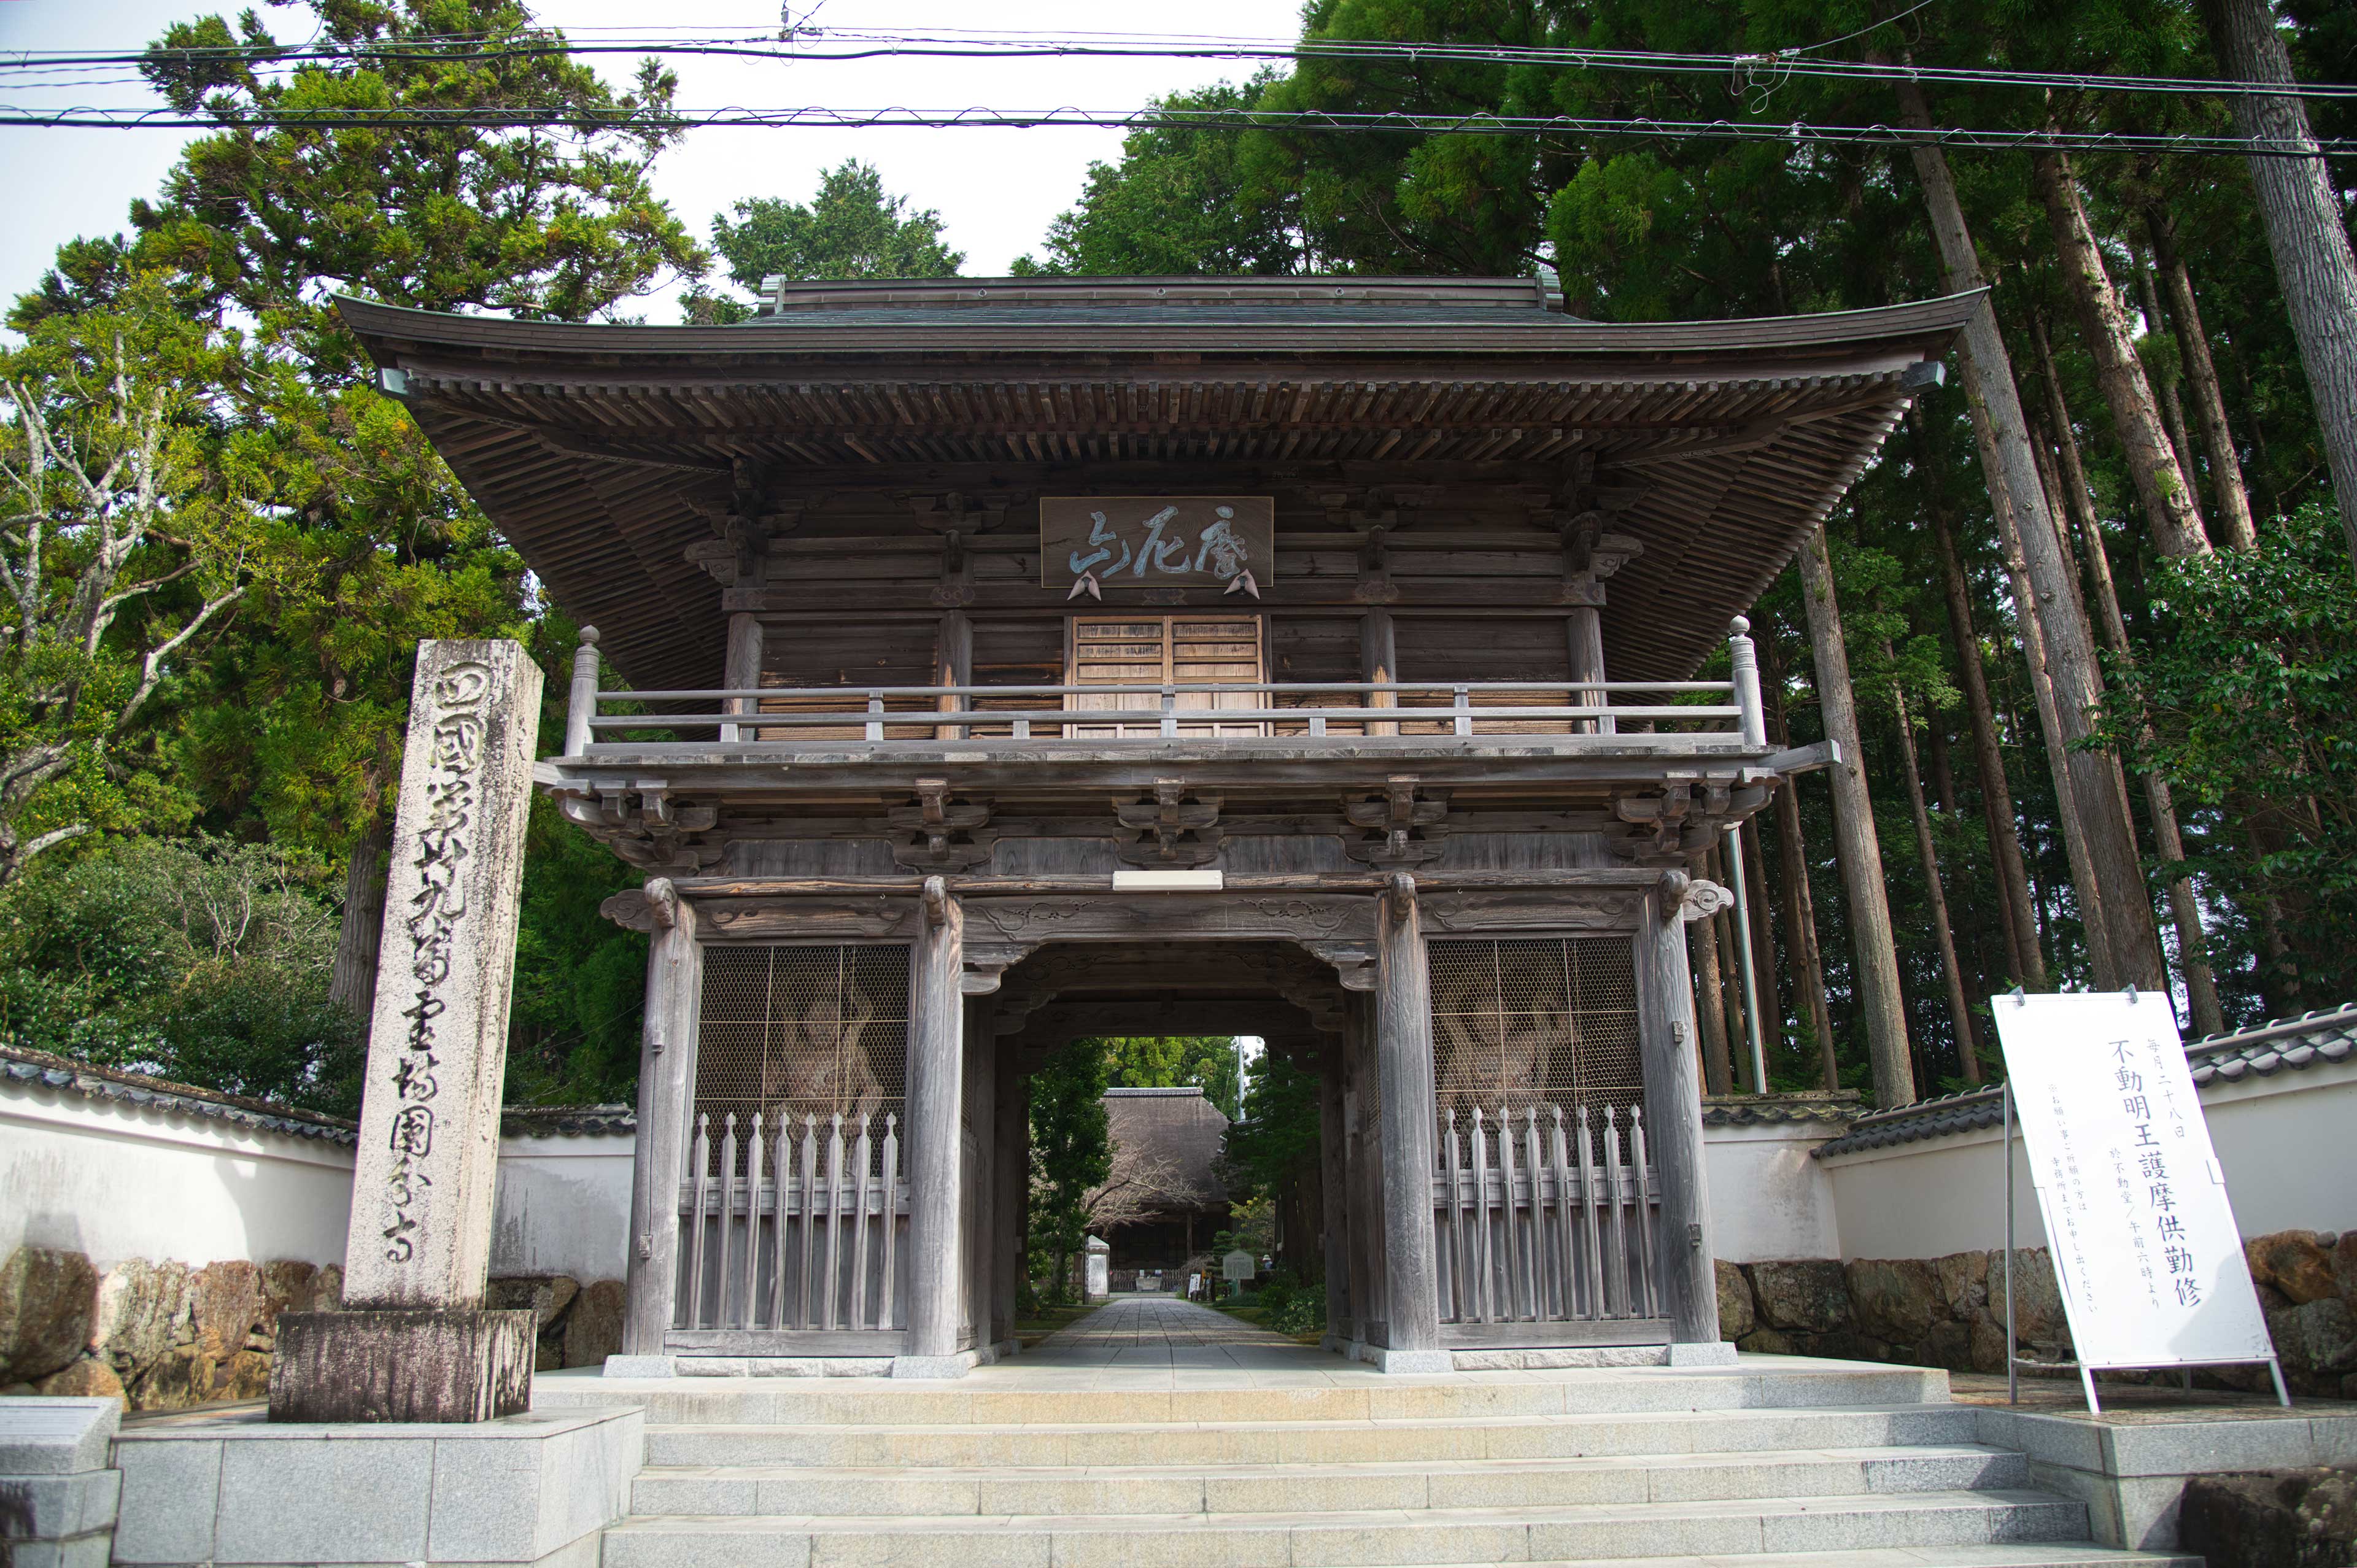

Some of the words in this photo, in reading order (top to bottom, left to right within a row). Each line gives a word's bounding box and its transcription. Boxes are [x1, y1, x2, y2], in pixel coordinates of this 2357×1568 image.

[2146, 1038, 2185, 1139] 毎月二十八日
[2051, 1156, 2098, 1313] 寺務所までお申し出ください
[2108, 1039, 2203, 1308] 不動明王護摩供勤修
